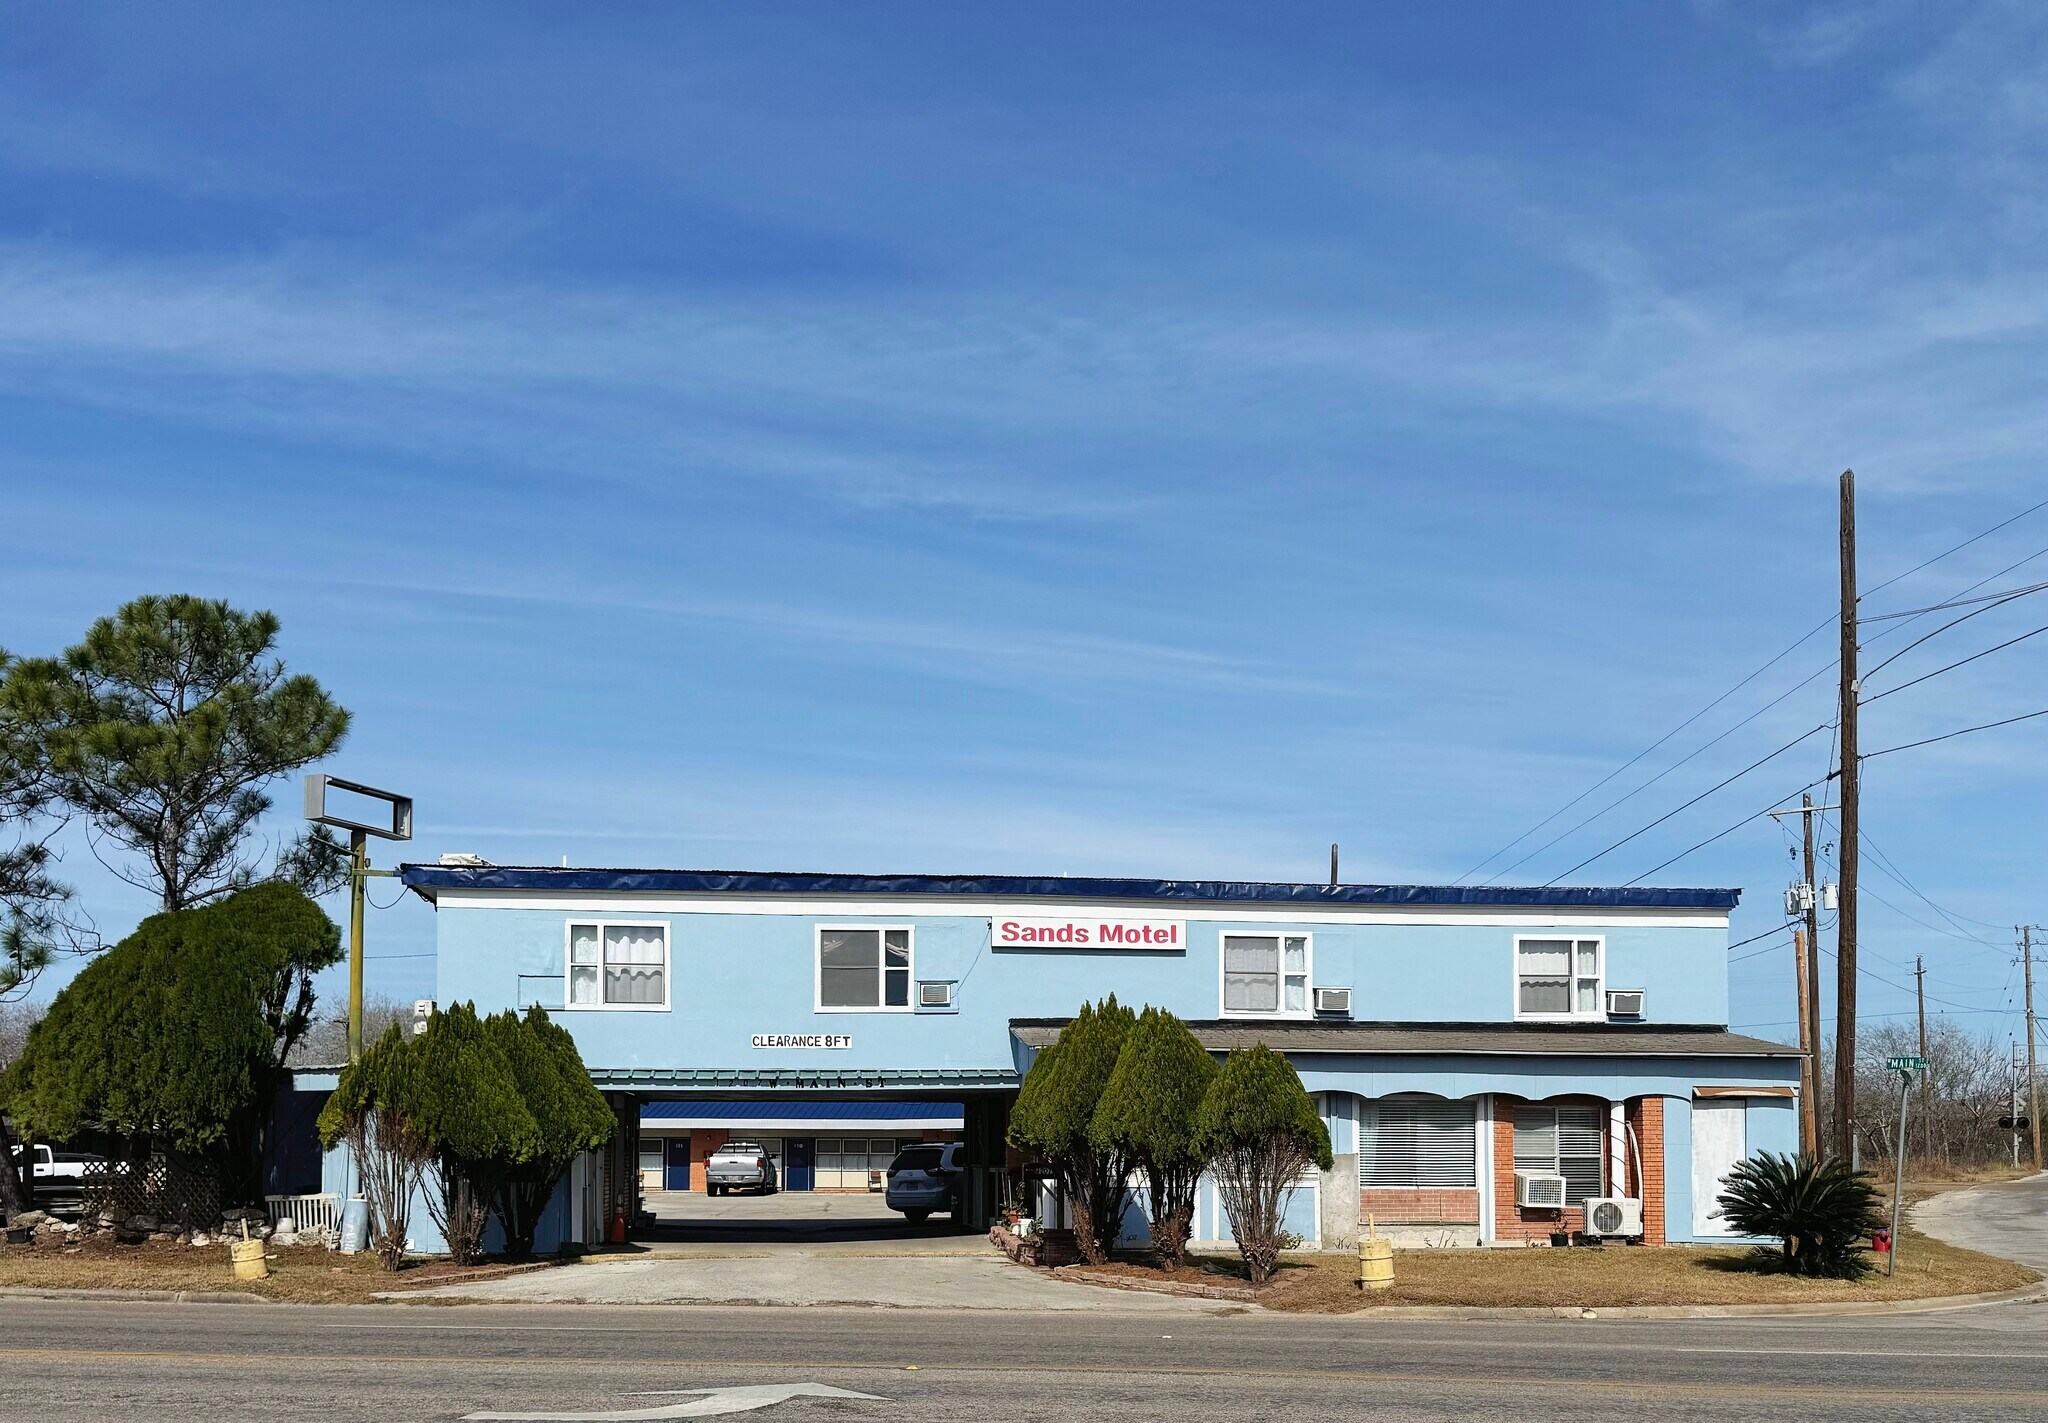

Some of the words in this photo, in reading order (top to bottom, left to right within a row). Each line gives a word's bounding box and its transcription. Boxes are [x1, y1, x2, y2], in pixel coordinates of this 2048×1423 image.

[1001, 922, 1089, 943] Sands
[1100, 924, 1177, 944] Motel
[752, 1035, 822, 1047] CLEARANCE
[825, 1035, 851, 1047] 8FT
[1891, 1059, 1914, 1068] MAIN
[716, 1079, 763, 1088] 1207
[769, 1078, 779, 1089] W
[795, 1078, 846, 1089] MAIN
[865, 1078, 887, 1089] ST
